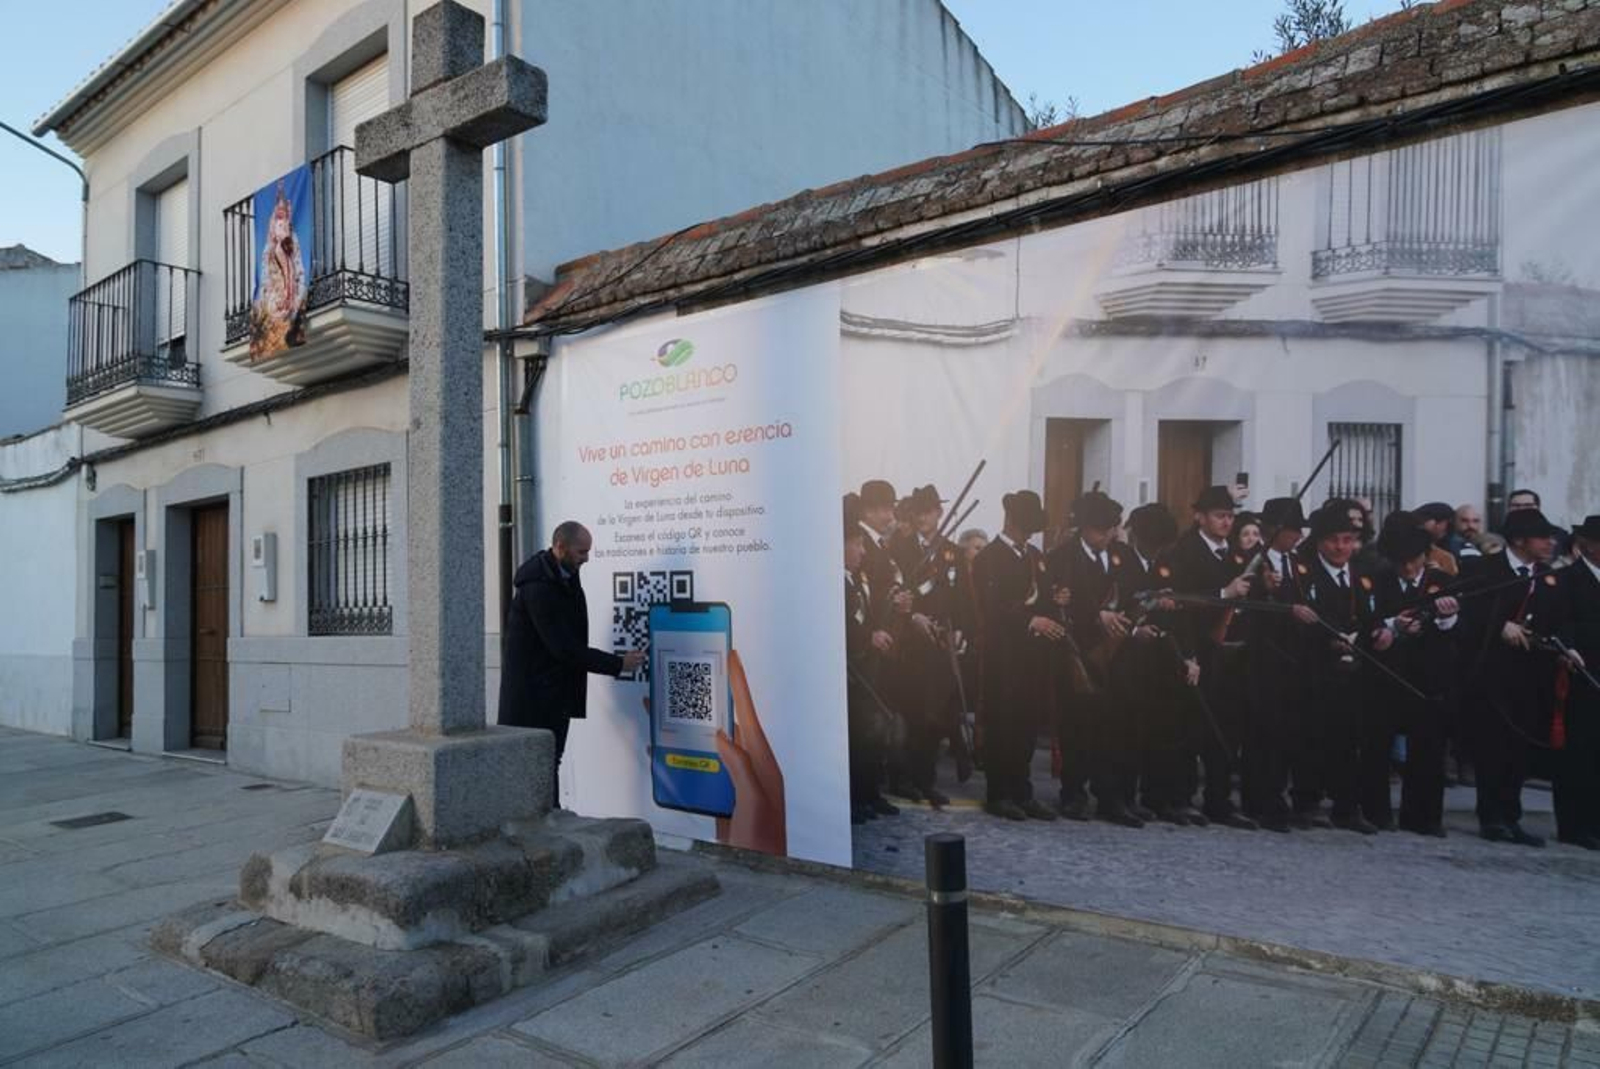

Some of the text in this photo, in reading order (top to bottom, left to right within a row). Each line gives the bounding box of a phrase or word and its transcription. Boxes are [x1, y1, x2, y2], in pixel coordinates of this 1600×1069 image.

[619, 363, 737, 400] POZOBLANCO
[579, 419, 792, 463] Vive un camino con esencia
[610, 457, 750, 488] de Virgen de Luna
[683, 491, 698, 505] del
[699, 492, 733, 504] camino
[597, 513, 607, 526] de
[608, 512, 617, 525] la
[618, 511, 643, 527] Virgen
[644, 509, 656, 522] de
[656, 511, 676, 522] Luna
[677, 507, 704, 520] desde
[705, 508, 715, 519] tu
[647, 529, 656, 541] el
[657, 527, 687, 543] código
[688, 526, 703, 539] QR
[704, 530, 711, 542] y
[712, 526, 746, 538] conoce
[657, 545, 687, 556] historia
[688, 541, 701, 555] de
[702, 543, 735, 554] nuestro
